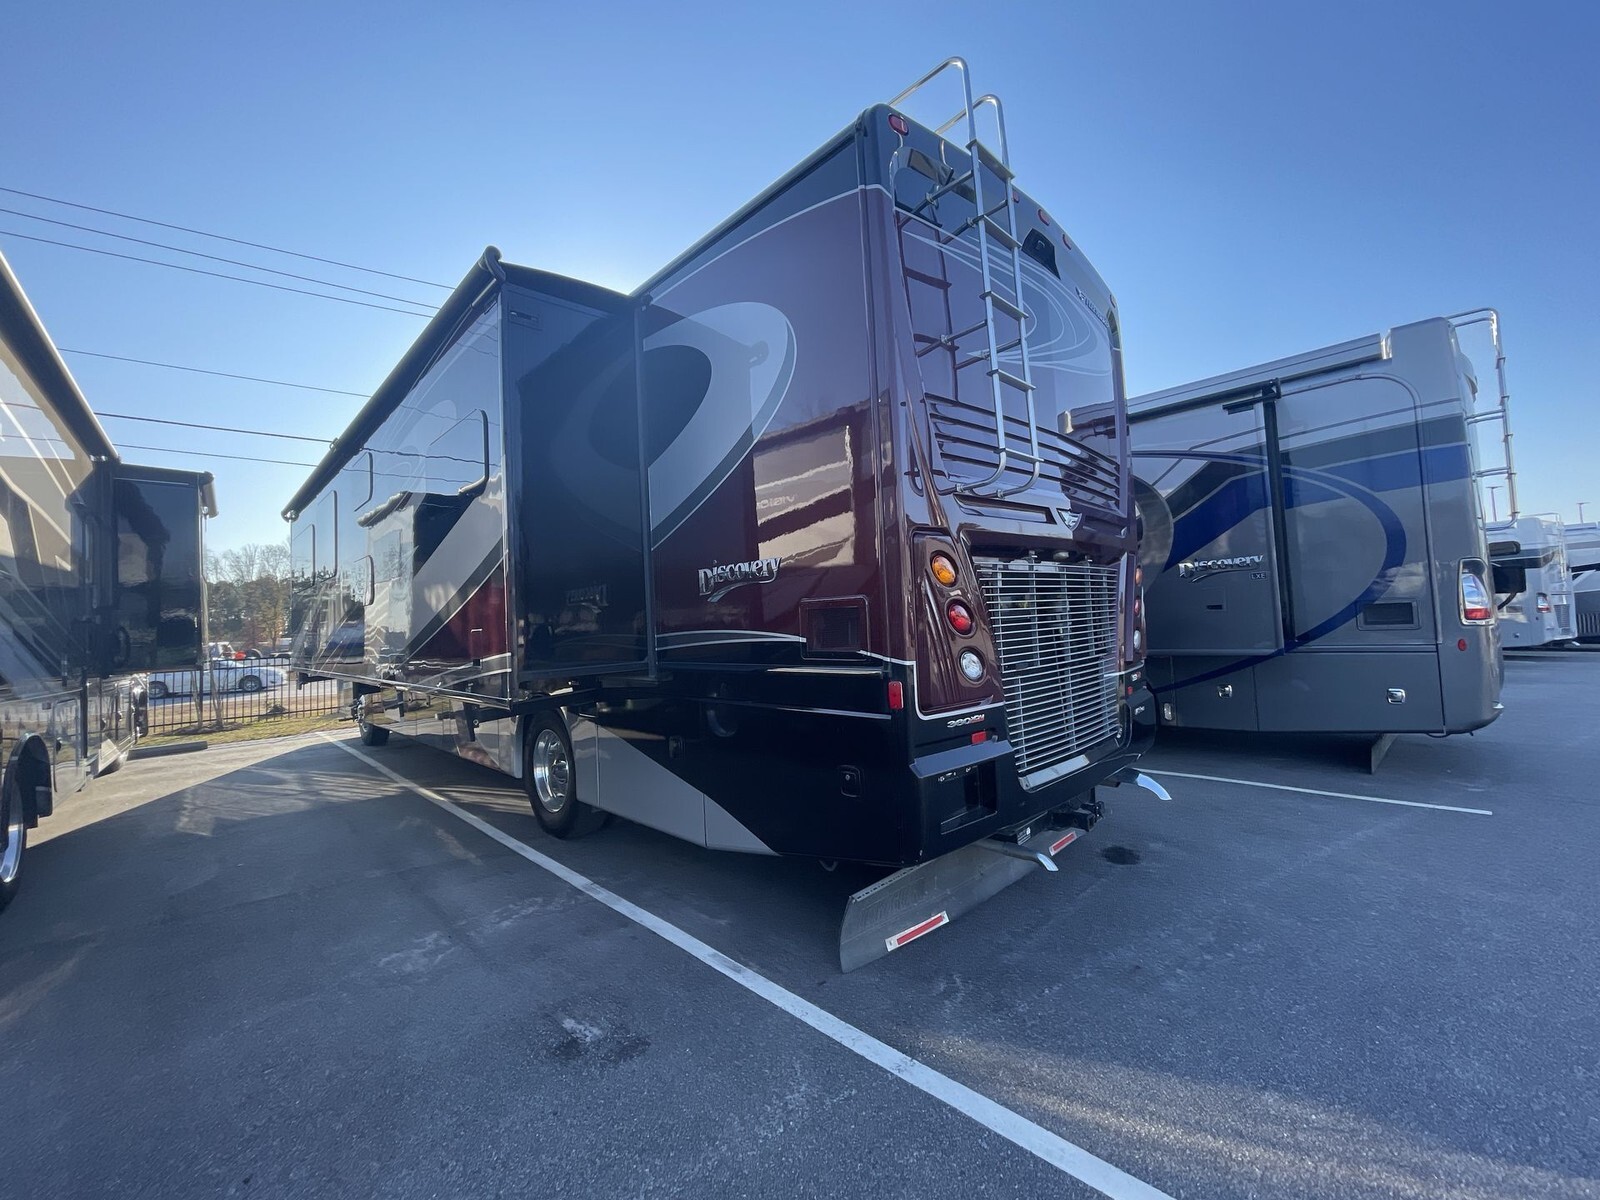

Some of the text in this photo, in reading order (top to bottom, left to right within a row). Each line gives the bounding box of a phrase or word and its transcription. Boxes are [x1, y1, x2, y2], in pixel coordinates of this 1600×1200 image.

[698, 557, 782, 596] Discovery
[1178, 555, 1264, 579] Discovery
[1250, 570, 1267, 580] LXE
